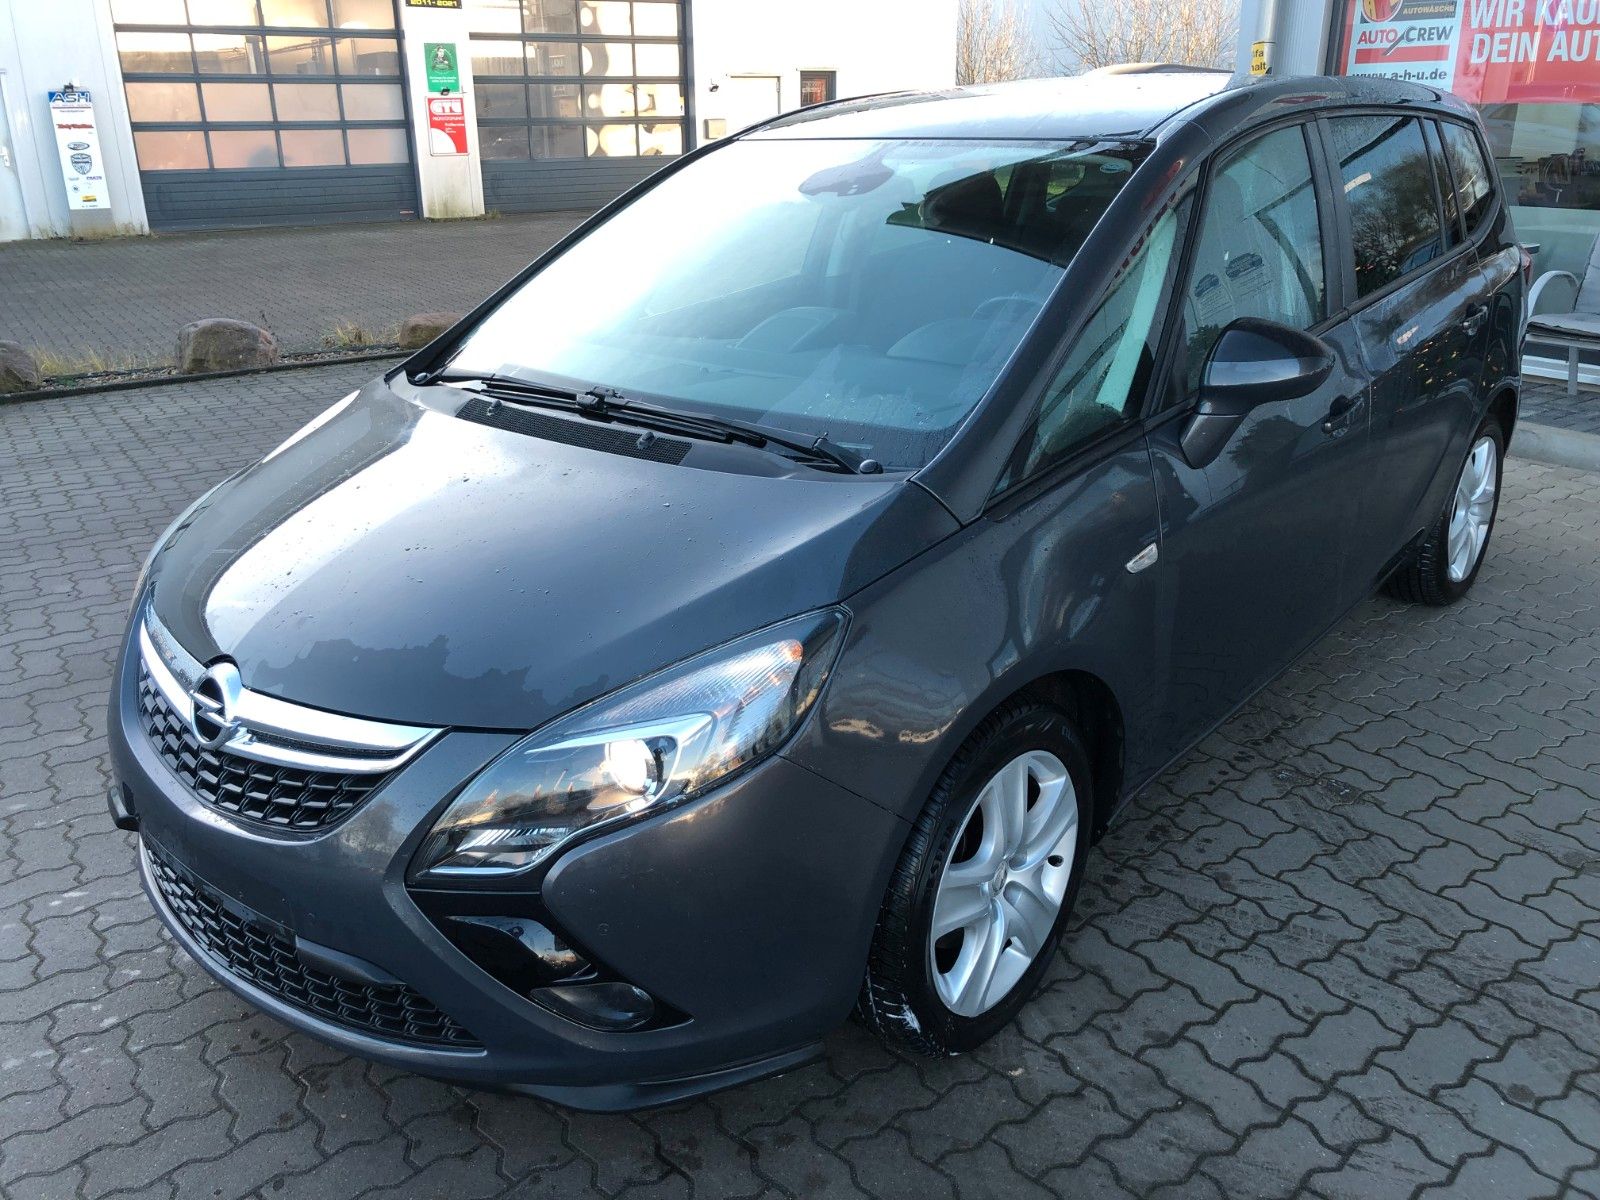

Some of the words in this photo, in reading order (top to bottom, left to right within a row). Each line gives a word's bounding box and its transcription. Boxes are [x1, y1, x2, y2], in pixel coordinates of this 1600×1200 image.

[1470, 0, 1525, 28] WIR
[1534, 0, 1600, 26] KAU
[1357, 28, 1398, 45] AUTO
[1405, 25, 1453, 42] CREW
[1471, 31, 1539, 64] DEIN
[51, 92, 91, 103] ASH
